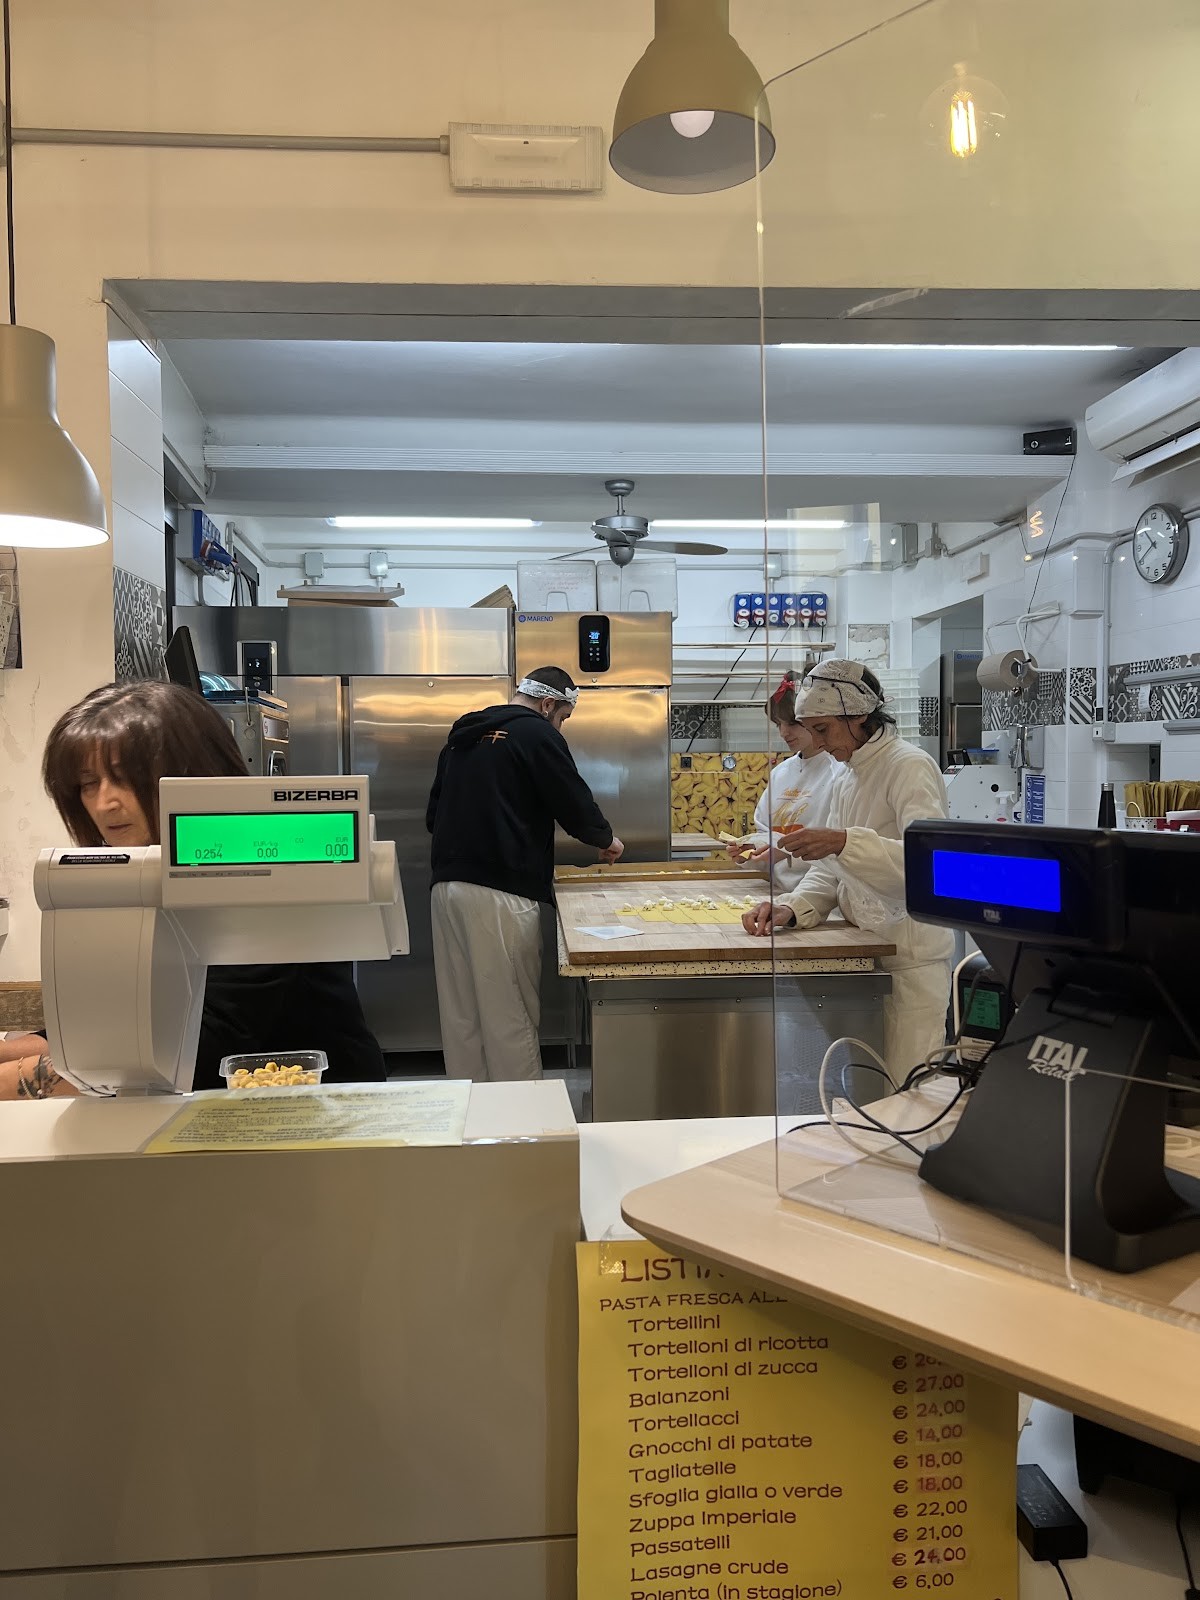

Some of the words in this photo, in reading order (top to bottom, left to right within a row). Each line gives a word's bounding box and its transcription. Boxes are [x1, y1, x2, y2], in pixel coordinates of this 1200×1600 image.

[273, 789, 359, 802] BIZERBA
[253, 840, 279, 848] EUR/kg
[1027, 1035, 1088, 1075] ITAL
[600, 1295, 662, 1311] PASTA
[667, 1291, 744, 1307] FRESCA
[627, 1314, 721, 1334] Tortellini
[627, 1338, 729, 1358] Tortelloni
[734, 1337, 752, 1353] di
[758, 1335, 829, 1352] ricotta
[627, 1362, 729, 1383] Tortelloni
[734, 1361, 752, 1377] di
[757, 1360, 818, 1375] zucca
[892, 1355, 907, 1370] €
[628, 1386, 730, 1409] Balanzoni
[892, 1380, 907, 1395] €
[628, 1410, 740, 1433] Tortellacci
[892, 1405, 908, 1420] €
[628, 1435, 712, 1459] Gnocchi
[717, 1434, 736, 1450] di
[741, 1433, 813, 1452] patate
[892, 1430, 908, 1445] €
[628, 1461, 737, 1484] Tagliatelle
[893, 1455, 908, 1470] €
[629, 1487, 700, 1509] Sfoglia
[705, 1485, 758, 1504] gialla
[764, 1485, 777, 1499] o
[782, 1483, 843, 1499] verde
[893, 1479, 908, 1494] €
[629, 1513, 696, 1533] Zuppa
[702, 1508, 797, 1528] Imperiale
[893, 1504, 908, 1518] €
[630, 1534, 731, 1558] Passatelli
[893, 1528, 908, 1542] €
[630, 1561, 722, 1583] Lasagne
[727, 1559, 789, 1576] crude
[891, 1552, 907, 1567] €
[630, 1584, 710, 1600] Polenta
[717, 1582, 740, 1600] (in
[746, 1579, 843, 1600] stagione)
[892, 1575, 908, 1589] €
